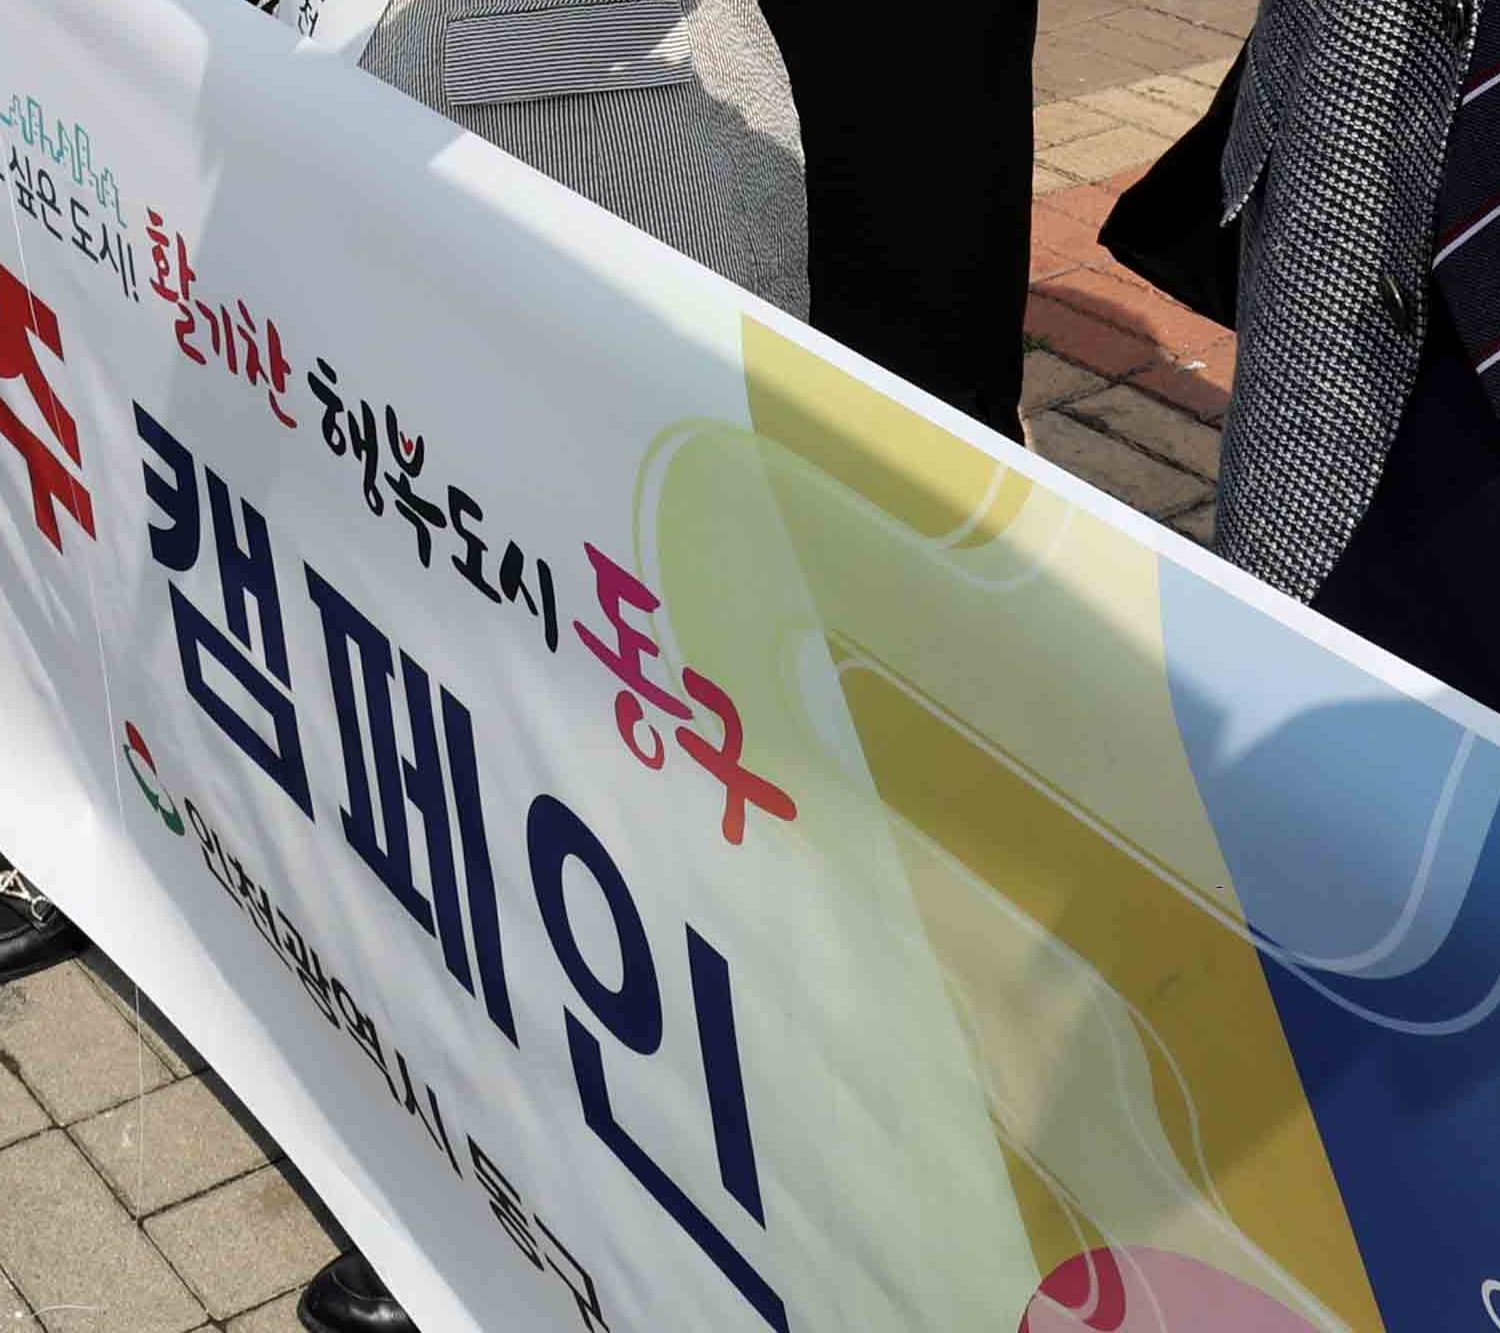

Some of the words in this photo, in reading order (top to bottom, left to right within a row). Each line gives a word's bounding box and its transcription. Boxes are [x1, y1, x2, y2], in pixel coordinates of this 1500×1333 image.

[6, 153, 67, 243] 싶은
[68, 196, 143, 307] 도시!
[145, 204, 299, 431] 활기찬
[305, 354, 561, 655] 행복도시
[570, 540, 800, 848] 동구
[132, 398, 792, 1333] 캠페인
[182, 793, 464, 1181] 인천광역시
[464, 1133, 612, 1333] 동구
